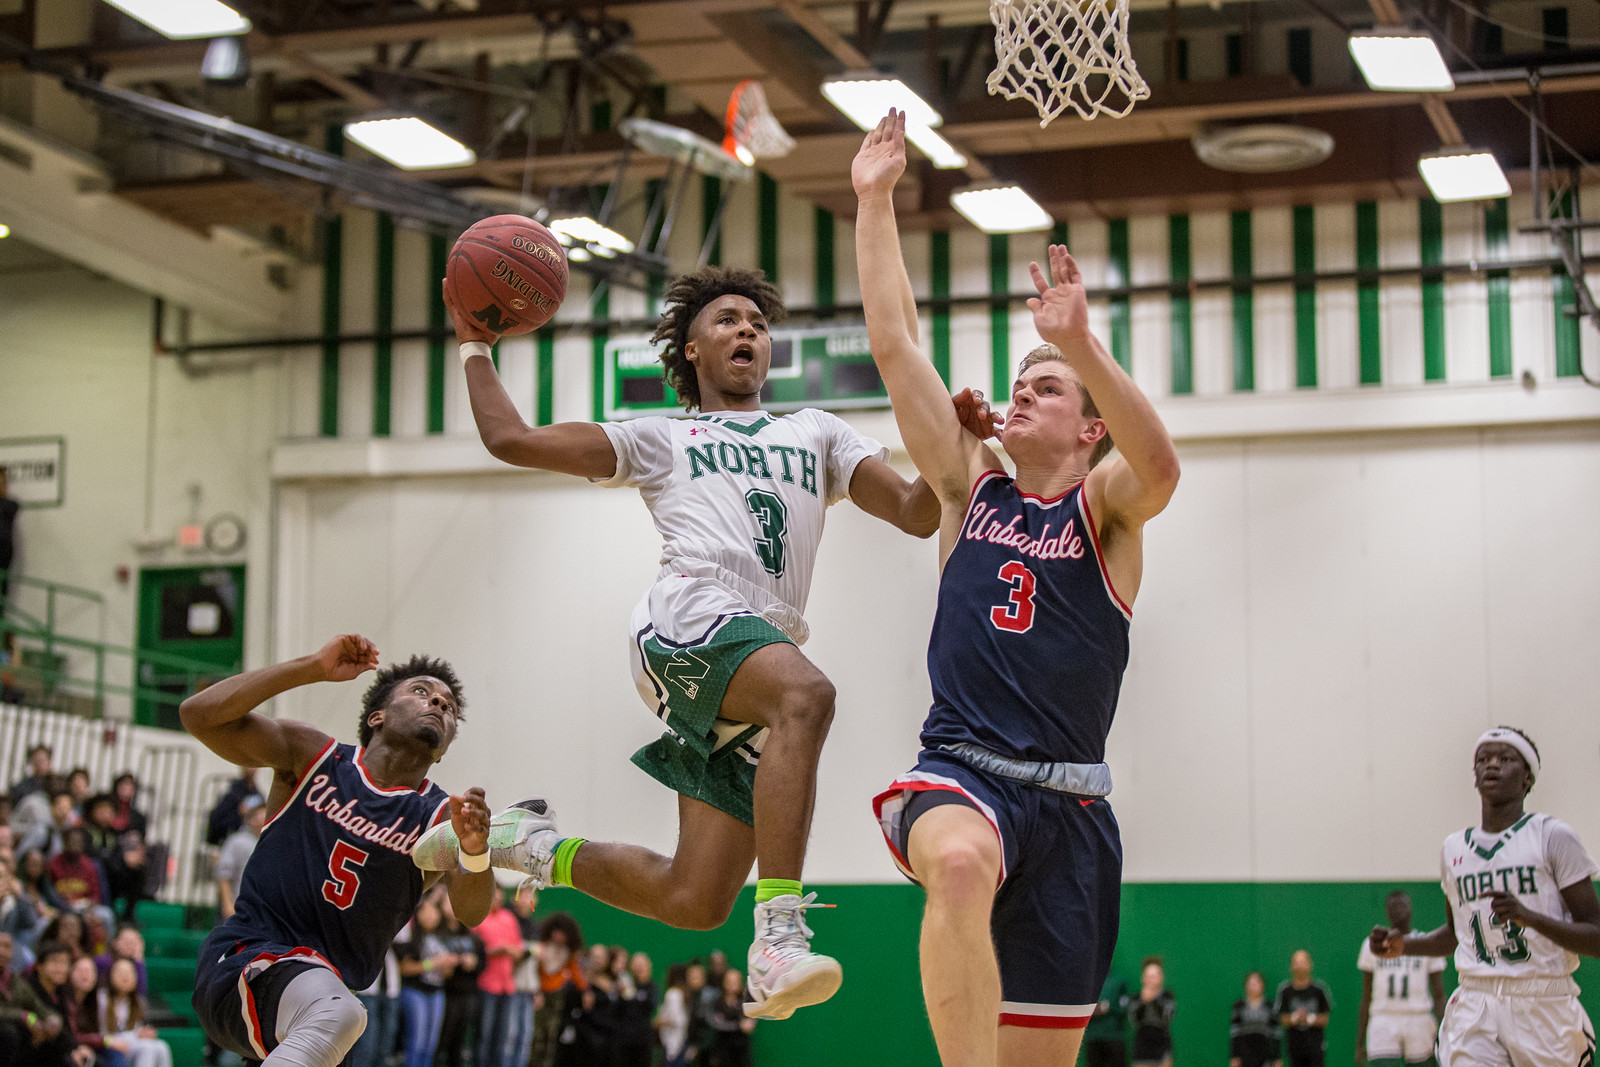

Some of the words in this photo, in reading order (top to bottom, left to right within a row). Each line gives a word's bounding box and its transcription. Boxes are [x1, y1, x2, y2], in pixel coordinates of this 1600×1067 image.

[492, 259, 557, 314] SPALDING
[617, 348, 664, 370] HOM
[826, 335, 871, 357] GUES
[684, 440, 818, 498] NORTH
[744, 487, 788, 579] 3
[989, 560, 1036, 633] 3
[305, 773, 421, 857] Urbandal
[321, 838, 370, 911] 5
[1468, 909, 1533, 967] 13
[1388, 974, 1411, 1002] 11
